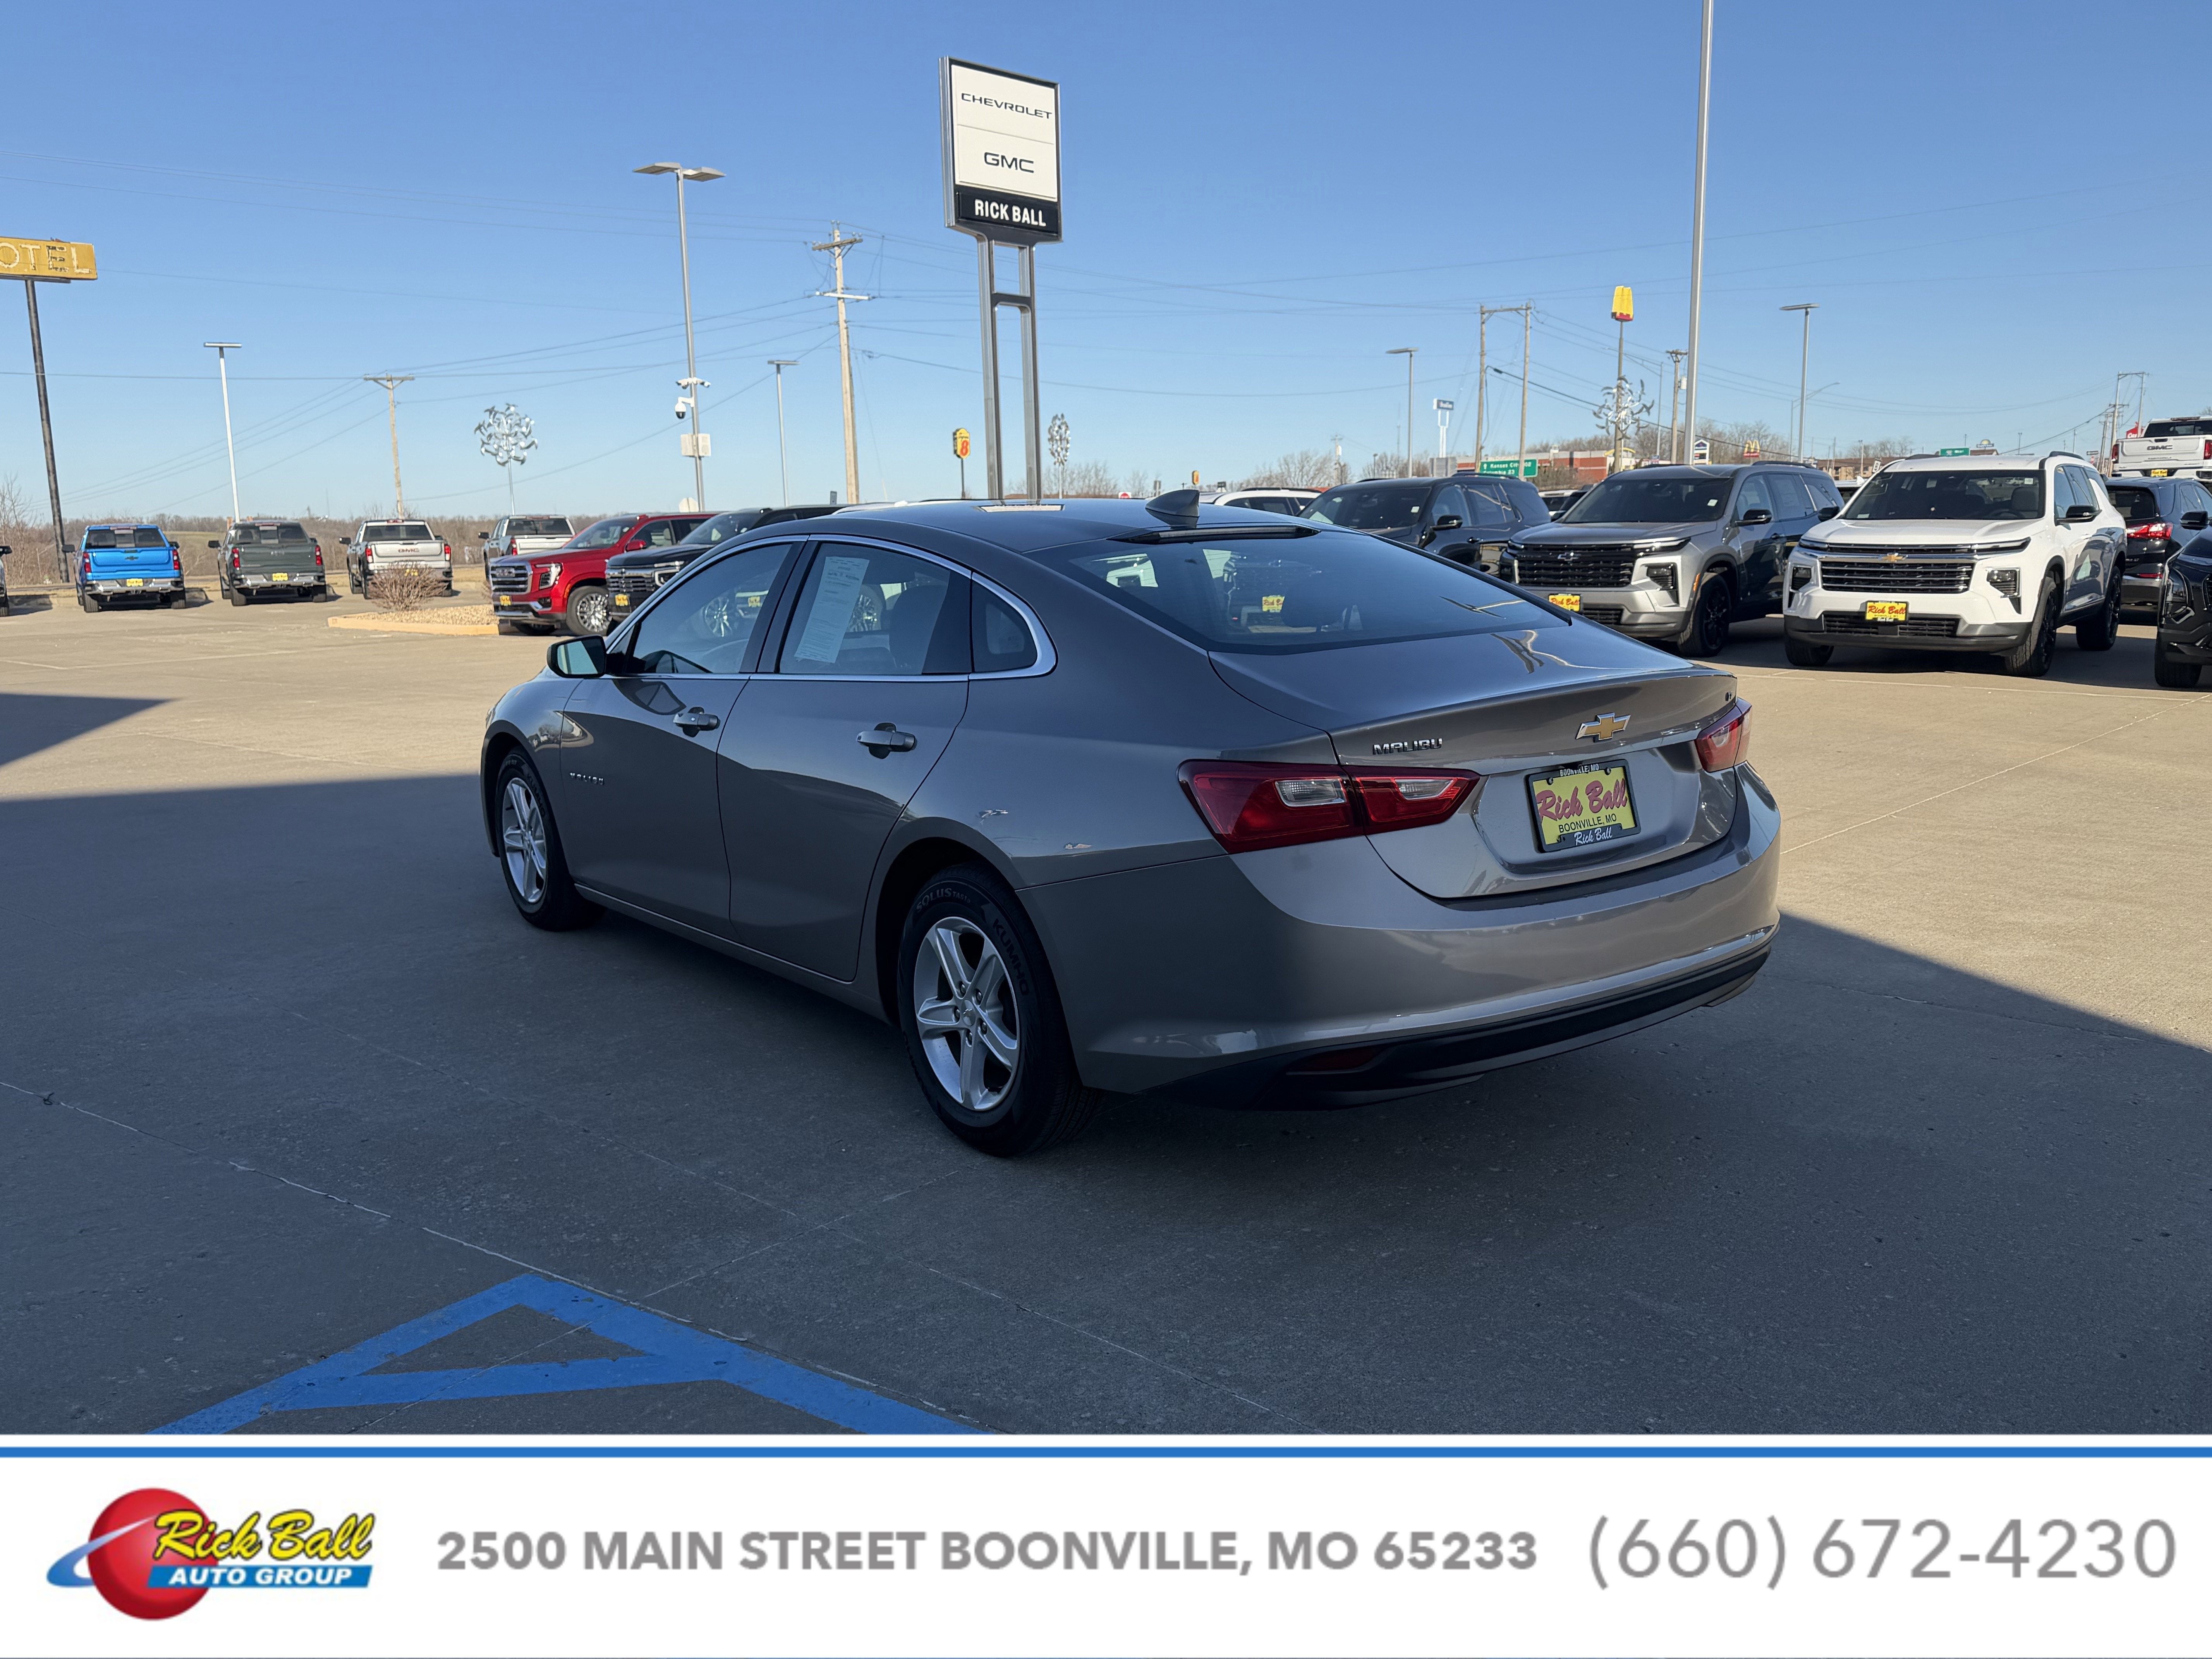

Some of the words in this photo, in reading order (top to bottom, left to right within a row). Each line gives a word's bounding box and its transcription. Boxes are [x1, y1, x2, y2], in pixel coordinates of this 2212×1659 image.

[961, 93, 1052, 119] CHEVROLET
[984, 151, 1034, 173] GMC
[974, 199, 1010, 221] RICK
[1012, 205, 1046, 227] BALL
[0, 242, 92, 273] OTEL
[1868, 605, 1886, 614] Rick
[1888, 606, 1906, 615] Ball
[1372, 738, 1443, 755] MALIBU
[1536, 785, 1583, 823] Rick
[1585, 778, 1628, 814] Ball
[1558, 816, 1605, 833] BOONVILLE,
[1606, 813, 1617, 823] MO
[1574, 830, 1594, 845] Rick
[1595, 827, 1613, 841] Ball
[916, 888, 952, 913] SOLUS
[992, 918, 1030, 996] KUMHO
